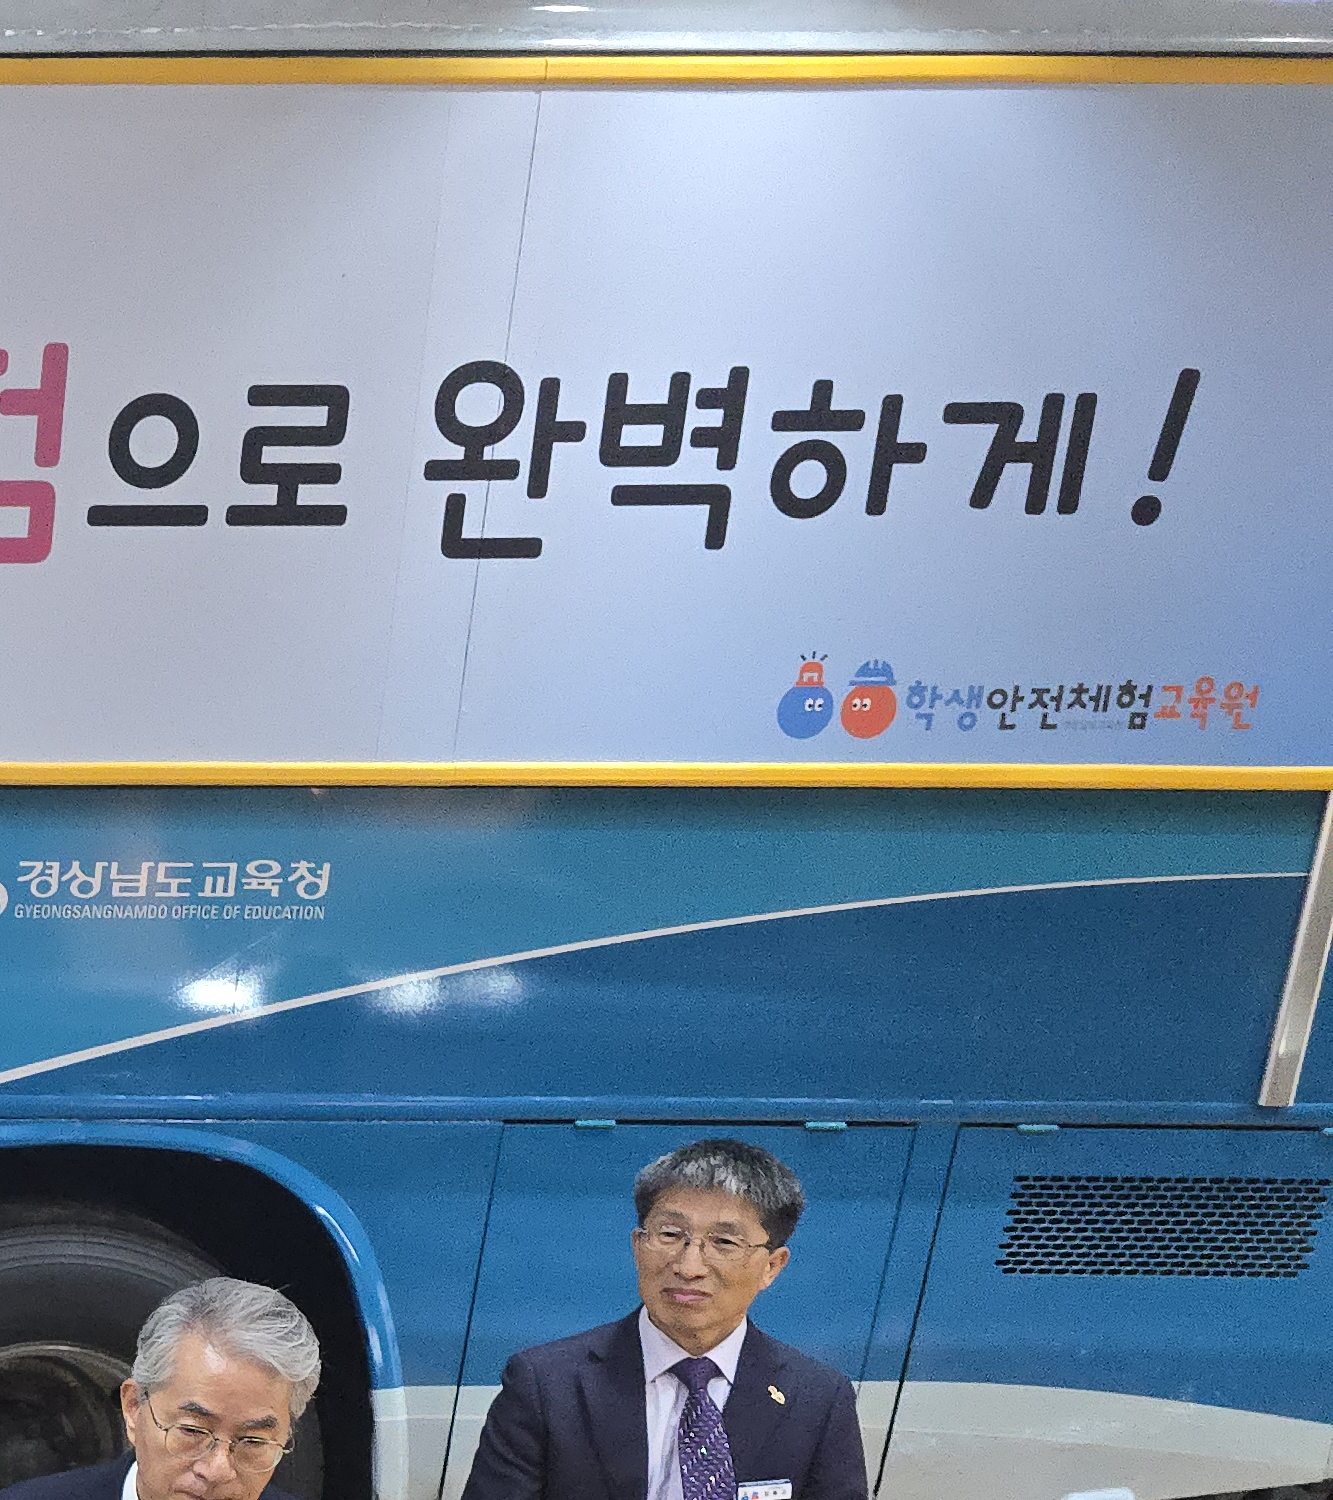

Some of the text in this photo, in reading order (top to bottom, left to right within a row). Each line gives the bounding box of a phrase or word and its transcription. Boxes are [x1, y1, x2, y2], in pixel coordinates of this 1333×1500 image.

[424, 360, 1201, 559] 완벽하게!
[905, 676, 1260, 731] 학생안전체험교육원
[17, 859, 332, 900] 경상남도교육청
[14, 903, 326, 920] GYEONGSANGNAMDO OFFICE OF EDUCATION
